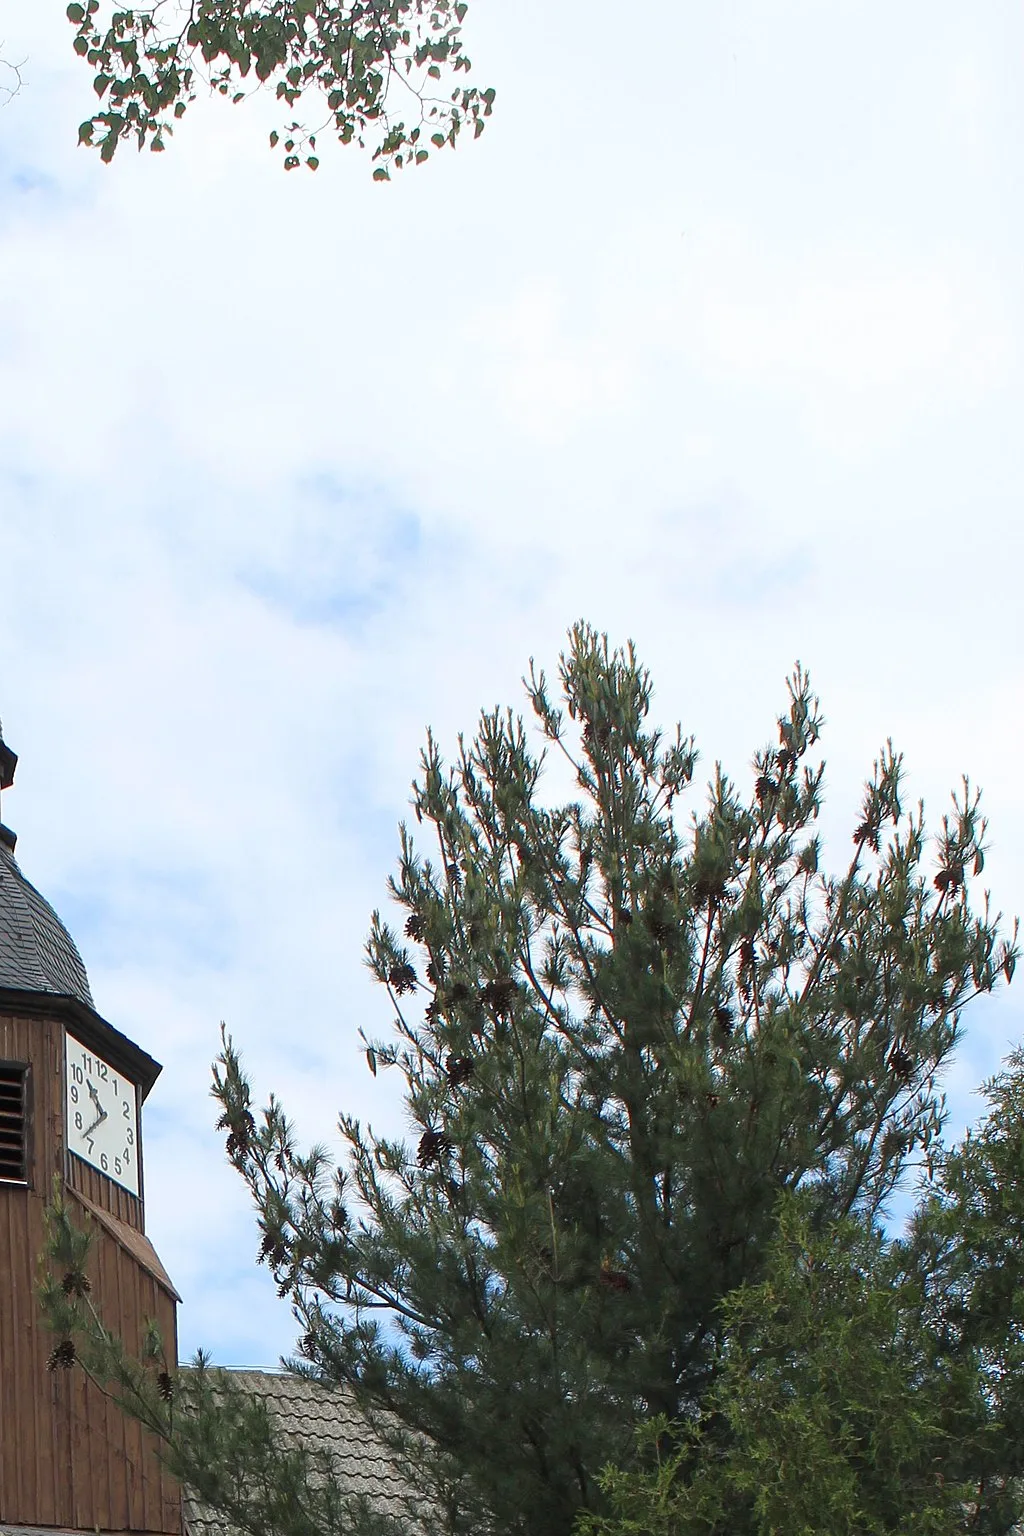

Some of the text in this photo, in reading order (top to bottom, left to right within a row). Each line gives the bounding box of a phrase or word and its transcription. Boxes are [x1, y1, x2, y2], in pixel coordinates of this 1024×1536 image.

[82, 1053, 91, 1074] 11
[95, 1060, 108, 1082] 12
[71, 1063, 83, 1084] 10
[71, 1086, 78, 1103] 9
[112, 1079, 117, 1096] 1
[123, 1101, 129, 1120] 2
[75, 1112, 82, 1130] 8
[127, 1128, 133, 1145] 3
[87, 1137, 94, 1154] 7
[100, 1154, 108, 1171] 6
[123, 1148, 130, 1164] 4
[115, 1157, 121, 1175] 5
